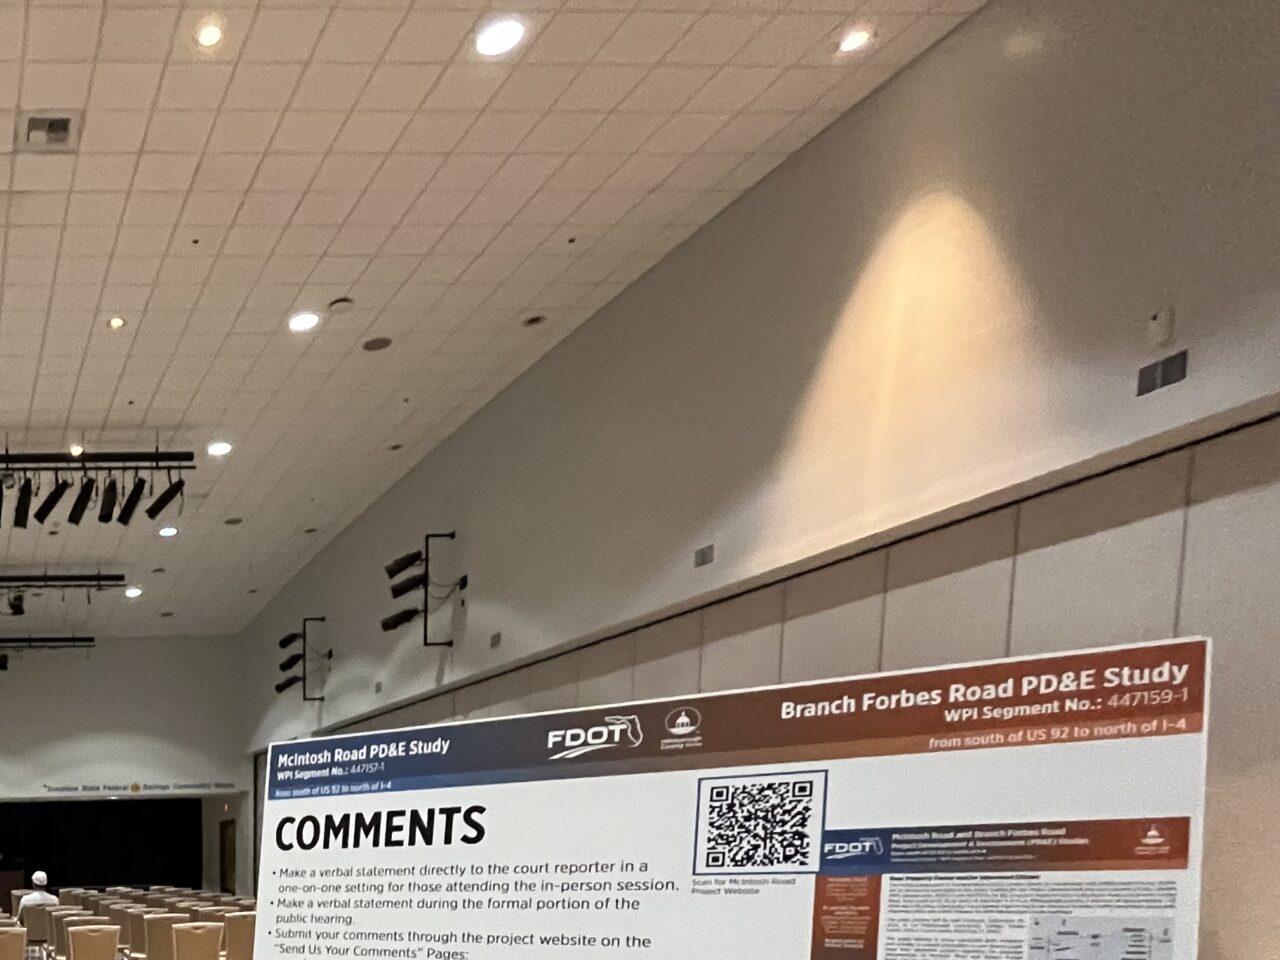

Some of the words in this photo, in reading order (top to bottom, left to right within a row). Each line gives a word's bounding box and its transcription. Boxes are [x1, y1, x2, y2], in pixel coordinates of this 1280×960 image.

[781, 696, 856, 719] Branch
[862, 689, 942, 711] Forbes
[949, 678, 1014, 703] Road
[1022, 668, 1096, 696] PD&E
[1103, 661, 1189, 688] Study
[944, 709, 978, 722] WPI
[982, 701, 1060, 720] Segment
[1064, 698, 1102, 711] No.:
[1107, 687, 1188, 708] 447159-1
[548, 724, 628, 748] FDOT
[929, 737, 961, 749] from
[964, 732, 1004, 746] south
[1008, 730, 1024, 742] of
[1026, 728, 1046, 741] US
[1050, 727, 1068, 740] 92
[1074, 726, 1090, 738] to
[1094, 722, 1136, 736] north
[1140, 720, 1157, 734] of
[1162, 718, 1186, 732] I-4
[278, 750, 331, 768] McIntosh
[334, 745, 366, 762] Road
[370, 742, 406, 758] PD&E
[409, 738, 450, 755] Study
[277, 770, 293, 780] WPI
[294, 768, 330, 780] Segment
[332, 766, 348, 776] No.:
[350, 762, 384, 773] 447157-1
[276, 806, 486, 850] COMMENTS
[824, 842, 874, 853] FDOT
[279, 868, 307, 878] Make
[310, 870, 316, 878] a
[319, 866, 353, 878] verbal
[356, 866, 416, 877] statement
[420, 864, 466, 877] directly
[470, 864, 484, 875] to
[488, 864, 508, 875] the
[514, 862, 549, 874] court
[554, 862, 616, 875] reporter
[620, 860, 634, 872] in
[639, 862, 648, 872] a
[278, 883, 342, 893] one-on-one
[345, 882, 384, 894] setting
[388, 882, 404, 892] for
[408, 882, 442, 892] those
[446, 880, 510, 894] attending
[514, 880, 536, 892] the
[540, 880, 612, 894] in-person
[616, 878, 680, 892] session.
[692, 878, 712, 886] Scan
[277, 899, 304, 909] Make
[317, 898, 350, 908] verbal
[354, 898, 412, 909] statement
[416, 898, 458, 910] during
[462, 898, 484, 910] the
[488, 898, 532, 910] formal
[536, 898, 590, 911] portion
[594, 898, 610, 910] of
[615, 898, 640, 910] the
[276, 914, 307, 924] public
[275, 928, 312, 939] Submit
[316, 930, 340, 940] your
[343, 930, 404, 942] comments
[408, 931, 458, 944] through
[462, 932, 483, 944] the
[486, 934, 534, 946] project
[540, 934, 596, 947] website
[601, 938, 620, 948] on
[626, 936, 652, 948] the
[274, 944, 305, 954] "Send
[308, 944, 322, 954] Us
[326, 945, 349, 956] Your
[353, 946, 422, 958] Comments"
[427, 948, 468, 960] Pages:
